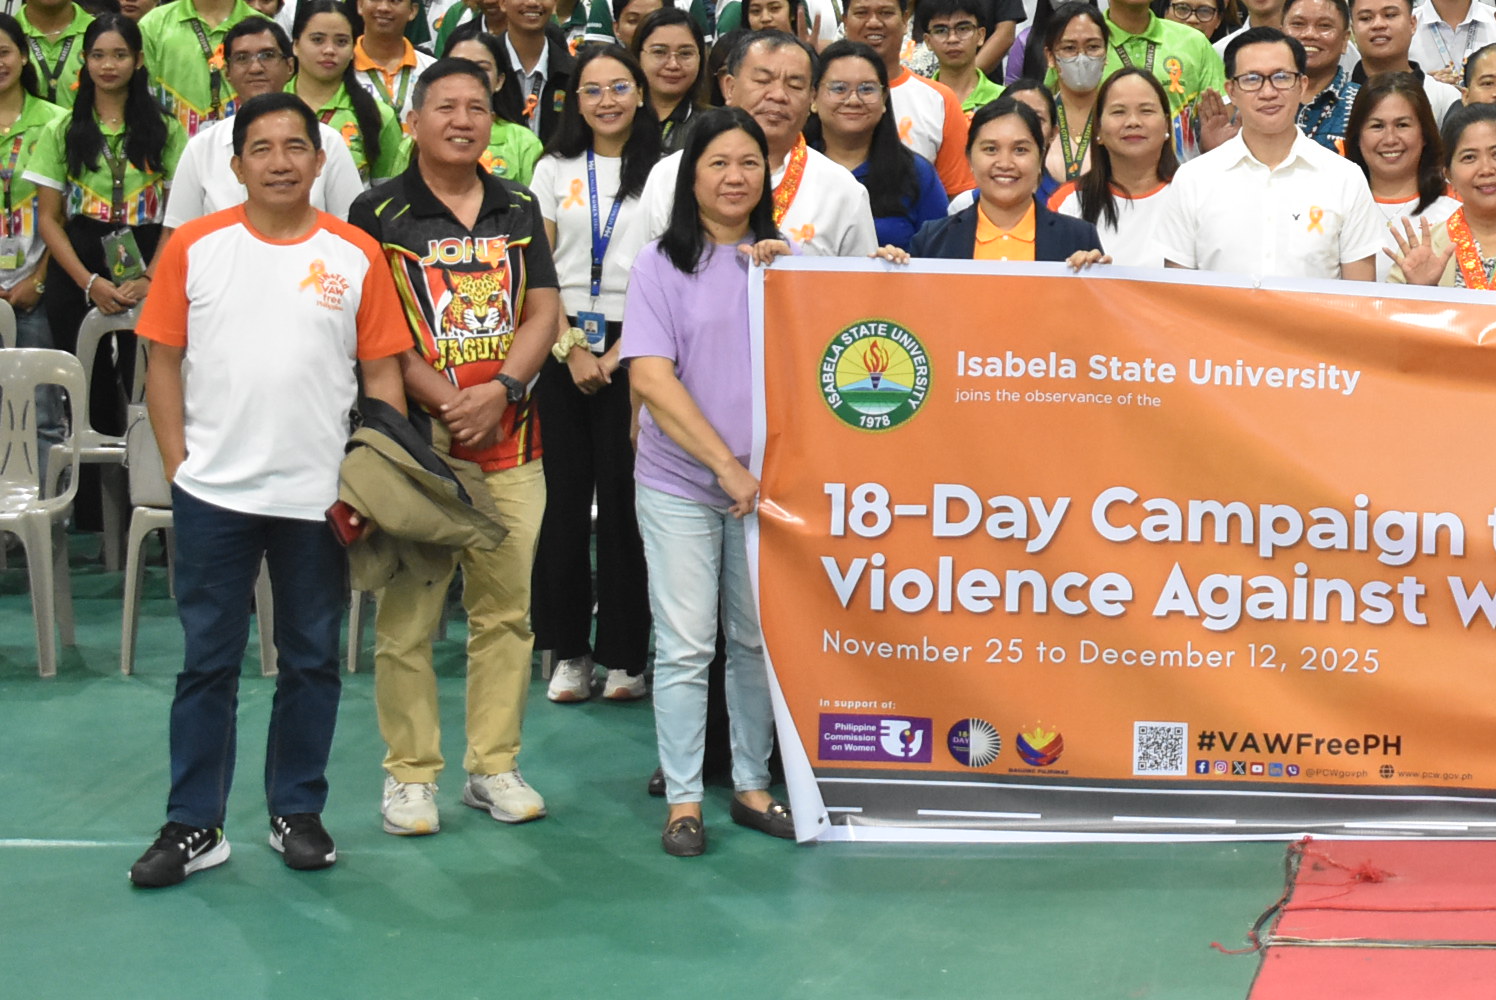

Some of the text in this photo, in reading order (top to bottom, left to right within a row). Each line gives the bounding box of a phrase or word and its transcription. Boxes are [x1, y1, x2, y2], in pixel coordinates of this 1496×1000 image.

[822, 323, 928, 410] ISABELA STATE UNIVERSITY
[956, 351, 1361, 396] Isabela State University
[954, 388, 1161, 407] joins the observance of the
[859, 415, 891, 428] 1978
[823, 482, 1072, 553] 18-Day
[1091, 485, 1466, 566] Campaign
[820, 552, 1134, 617] Violence
[1151, 561, 1429, 632] Against
[822, 629, 1380, 674] November 25 to December 12, 2025
[819, 698, 896, 710] In support of:
[835, 722, 877, 733] Philippine
[824, 733, 877, 742] Commission
[953, 736, 970, 744] DAY
[1197, 731, 1403, 756] #VAWFreePH
[844, 743, 877, 752] Women
[1305, 768, 1474, 782] @PCWgovph www.pcw.gov.ph
